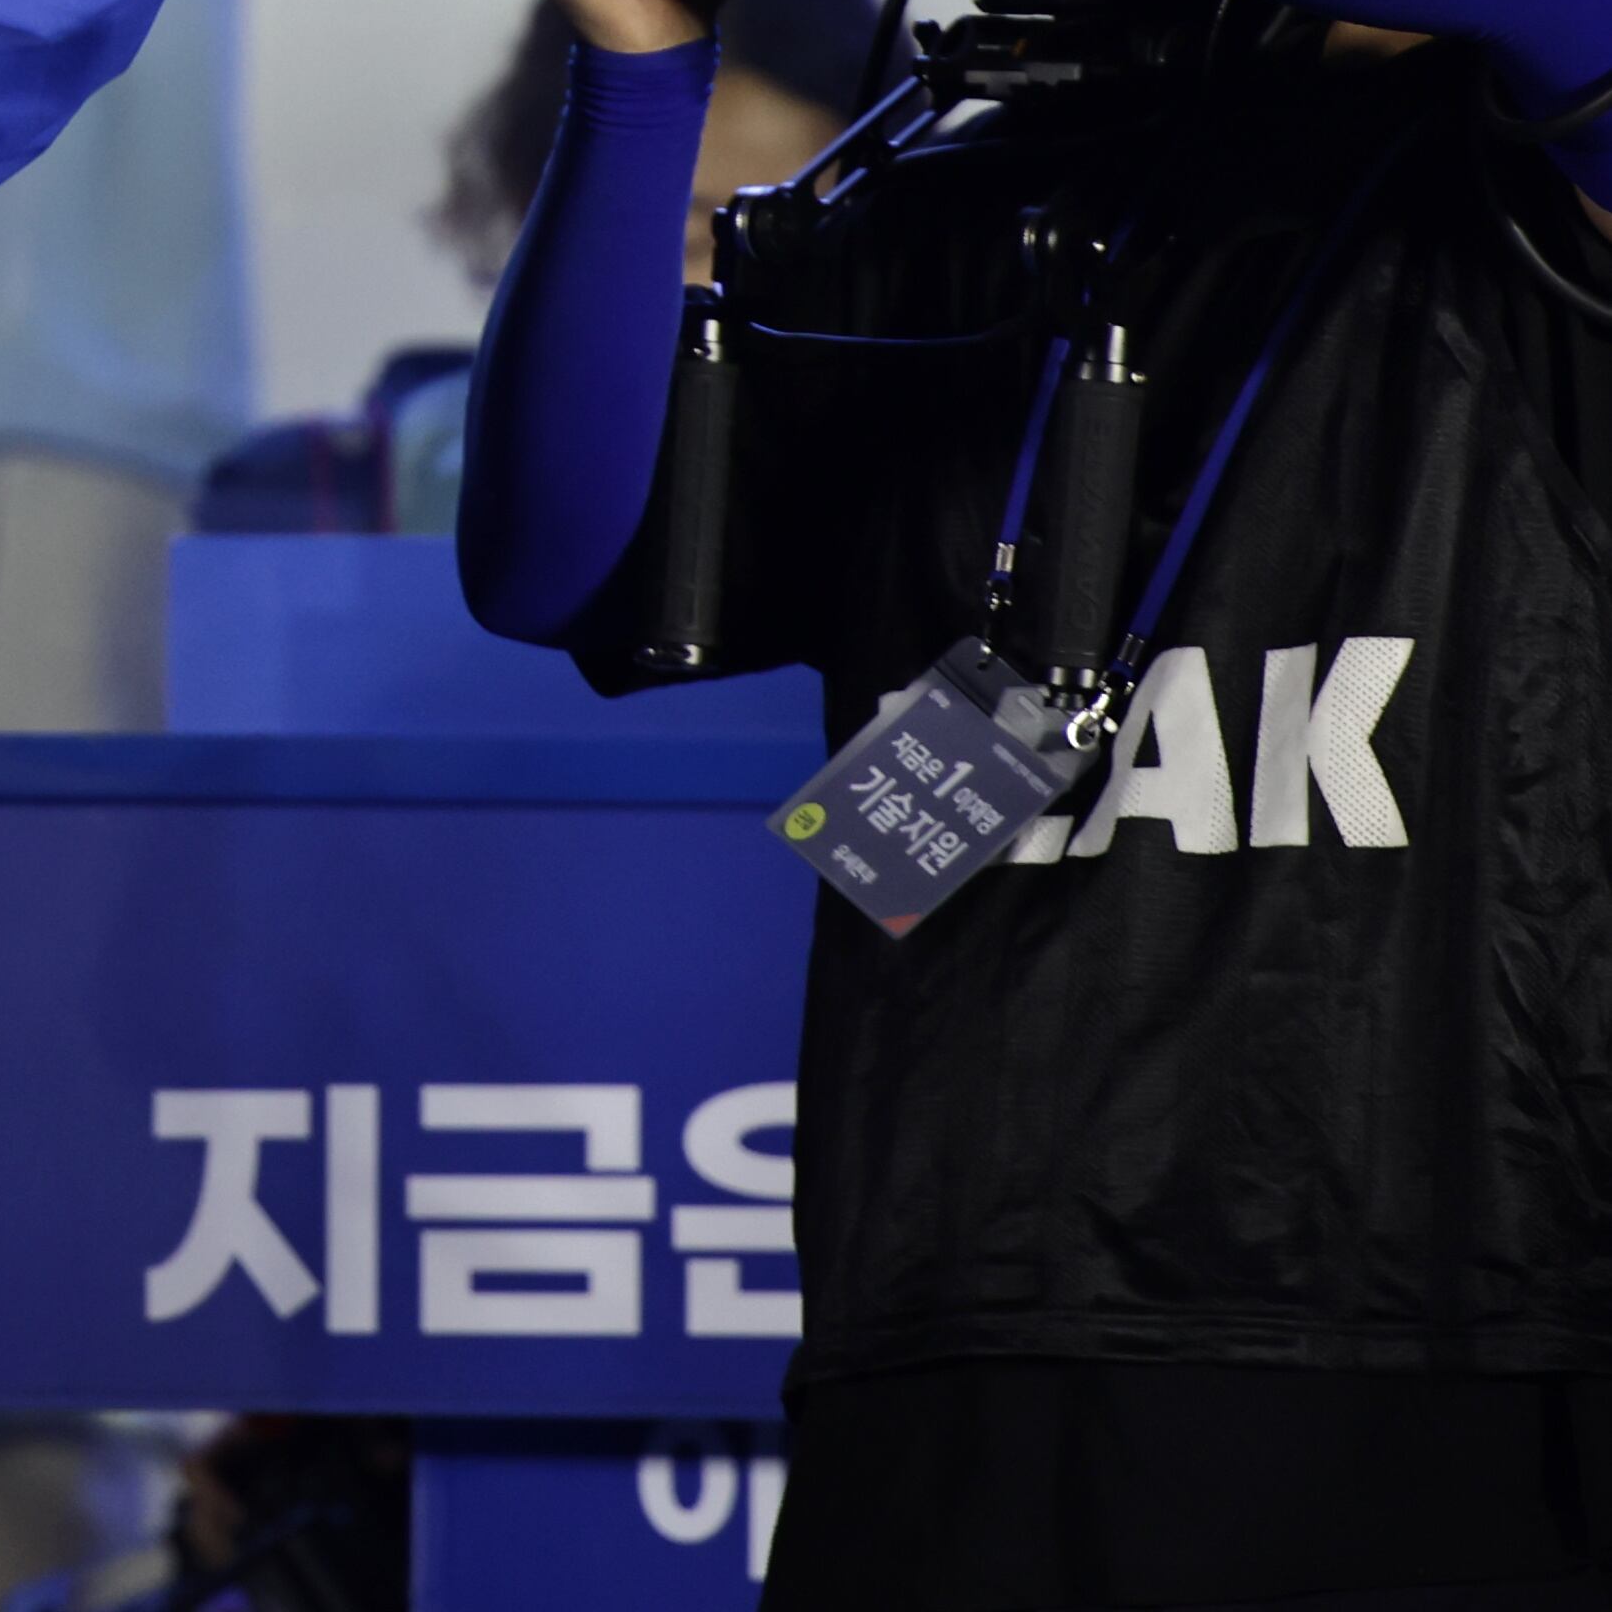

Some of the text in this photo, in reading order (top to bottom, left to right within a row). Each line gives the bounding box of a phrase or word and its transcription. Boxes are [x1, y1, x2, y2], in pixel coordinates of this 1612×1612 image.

[891, 731, 945, 784] 지금은
[933, 761, 974, 799] 1
[982, 636, 1415, 864] AK
[849, 765, 969, 876] 기술지원
[952, 787, 1006, 835] 이재명
[146, 1081, 803, 1337] 지금은
